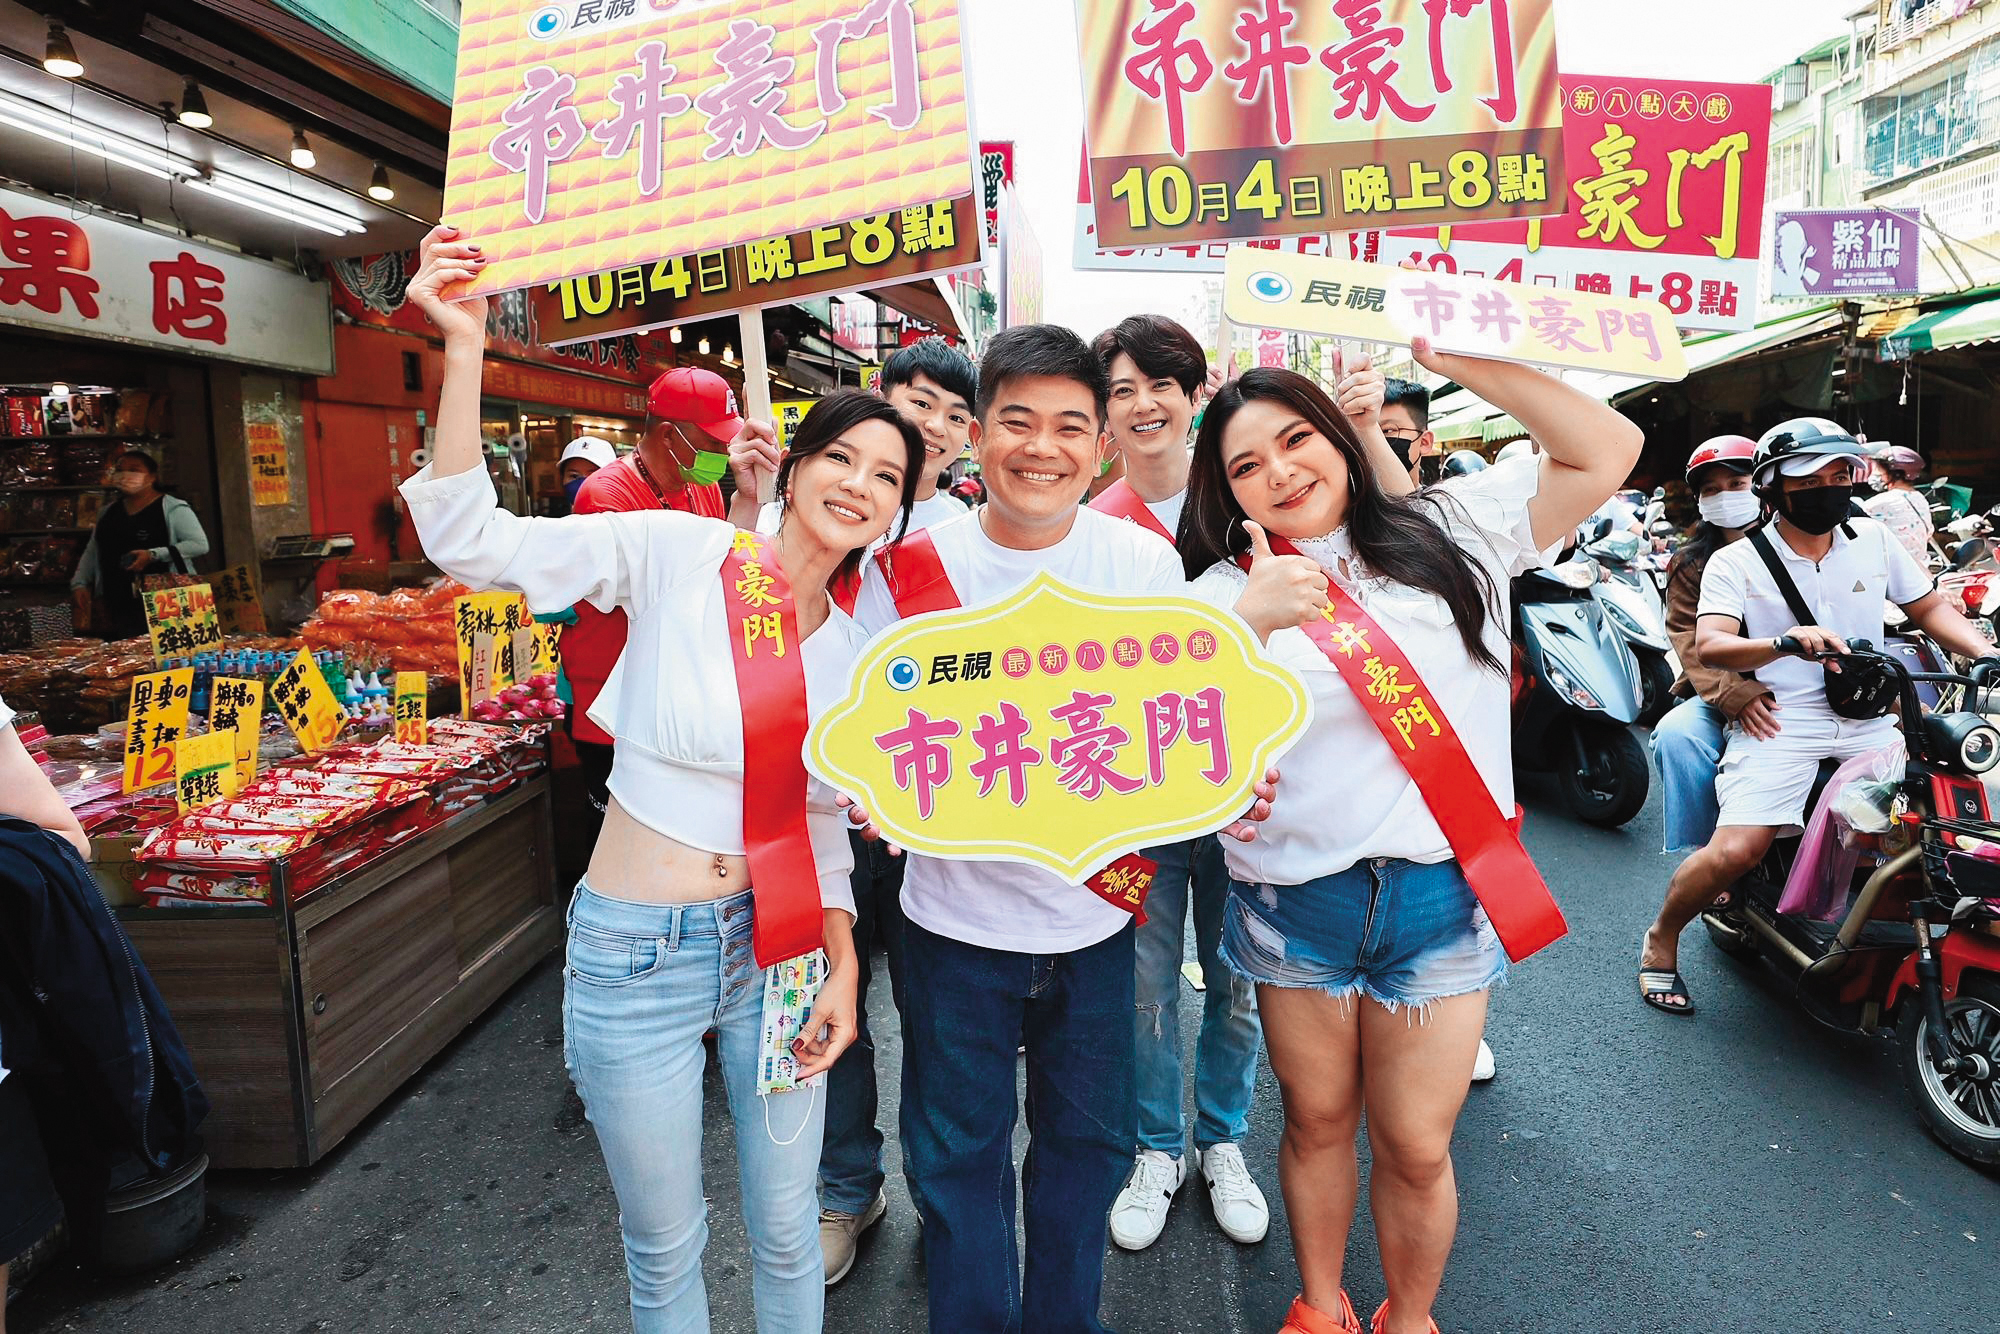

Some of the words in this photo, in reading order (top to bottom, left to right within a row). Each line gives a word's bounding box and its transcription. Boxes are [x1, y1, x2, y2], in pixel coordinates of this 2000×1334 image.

[489, 0, 921, 223] 市井豪門
[1125, 0, 1518, 157] 市井豪門
[1111, 158, 1325, 229] 10月4日
[1342, 150, 1547, 215] 晚上8點
[1832, 218, 1900, 253] 紫仙
[1832, 250, 1900, 270] 精品服飾
[1301, 279, 1387, 313] 民視
[1401, 280, 1662, 362] 市井豪門
[927, 651, 993, 685] 民視
[999, 629, 1219, 681] 最新八點大戲
[874, 687, 1233, 821] 市井豪門
[1100, 866, 1153, 905] 豪門
